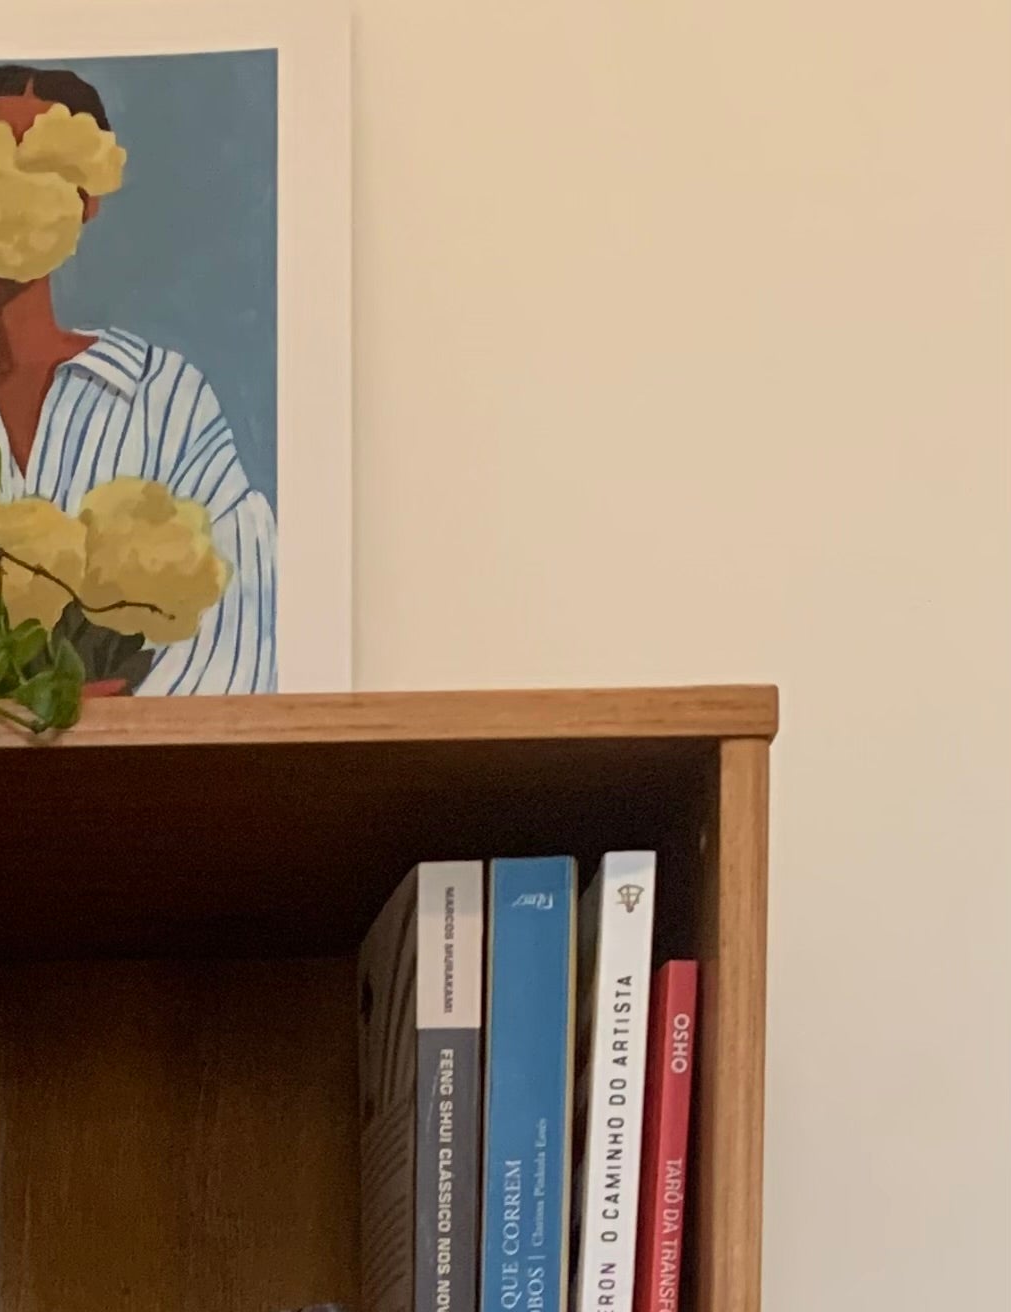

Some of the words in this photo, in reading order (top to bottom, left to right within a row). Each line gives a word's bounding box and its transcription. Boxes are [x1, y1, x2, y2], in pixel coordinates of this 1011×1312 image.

[444, 886, 455, 940] MARCOS
[443, 943, 454, 1013] MURAKAMI
[613, 976, 631, 1066] ARTISTA
[671, 1014, 689, 1072] OSHO
[441, 1050, 452, 1094] FENG
[609, 1079, 626, 1105] DO
[440, 1101, 452, 1141] SHUI
[603, 1118, 624, 1219] CAMINHO
[664, 1159, 684, 1204] TARÔ
[503, 1161, 521, 1255] CORREM
[663, 1209, 678, 1233] DA
[438, 1237, 450, 1275] NOS
[601, 1231, 617, 1242] O
[501, 1263, 521, 1310] QUE
